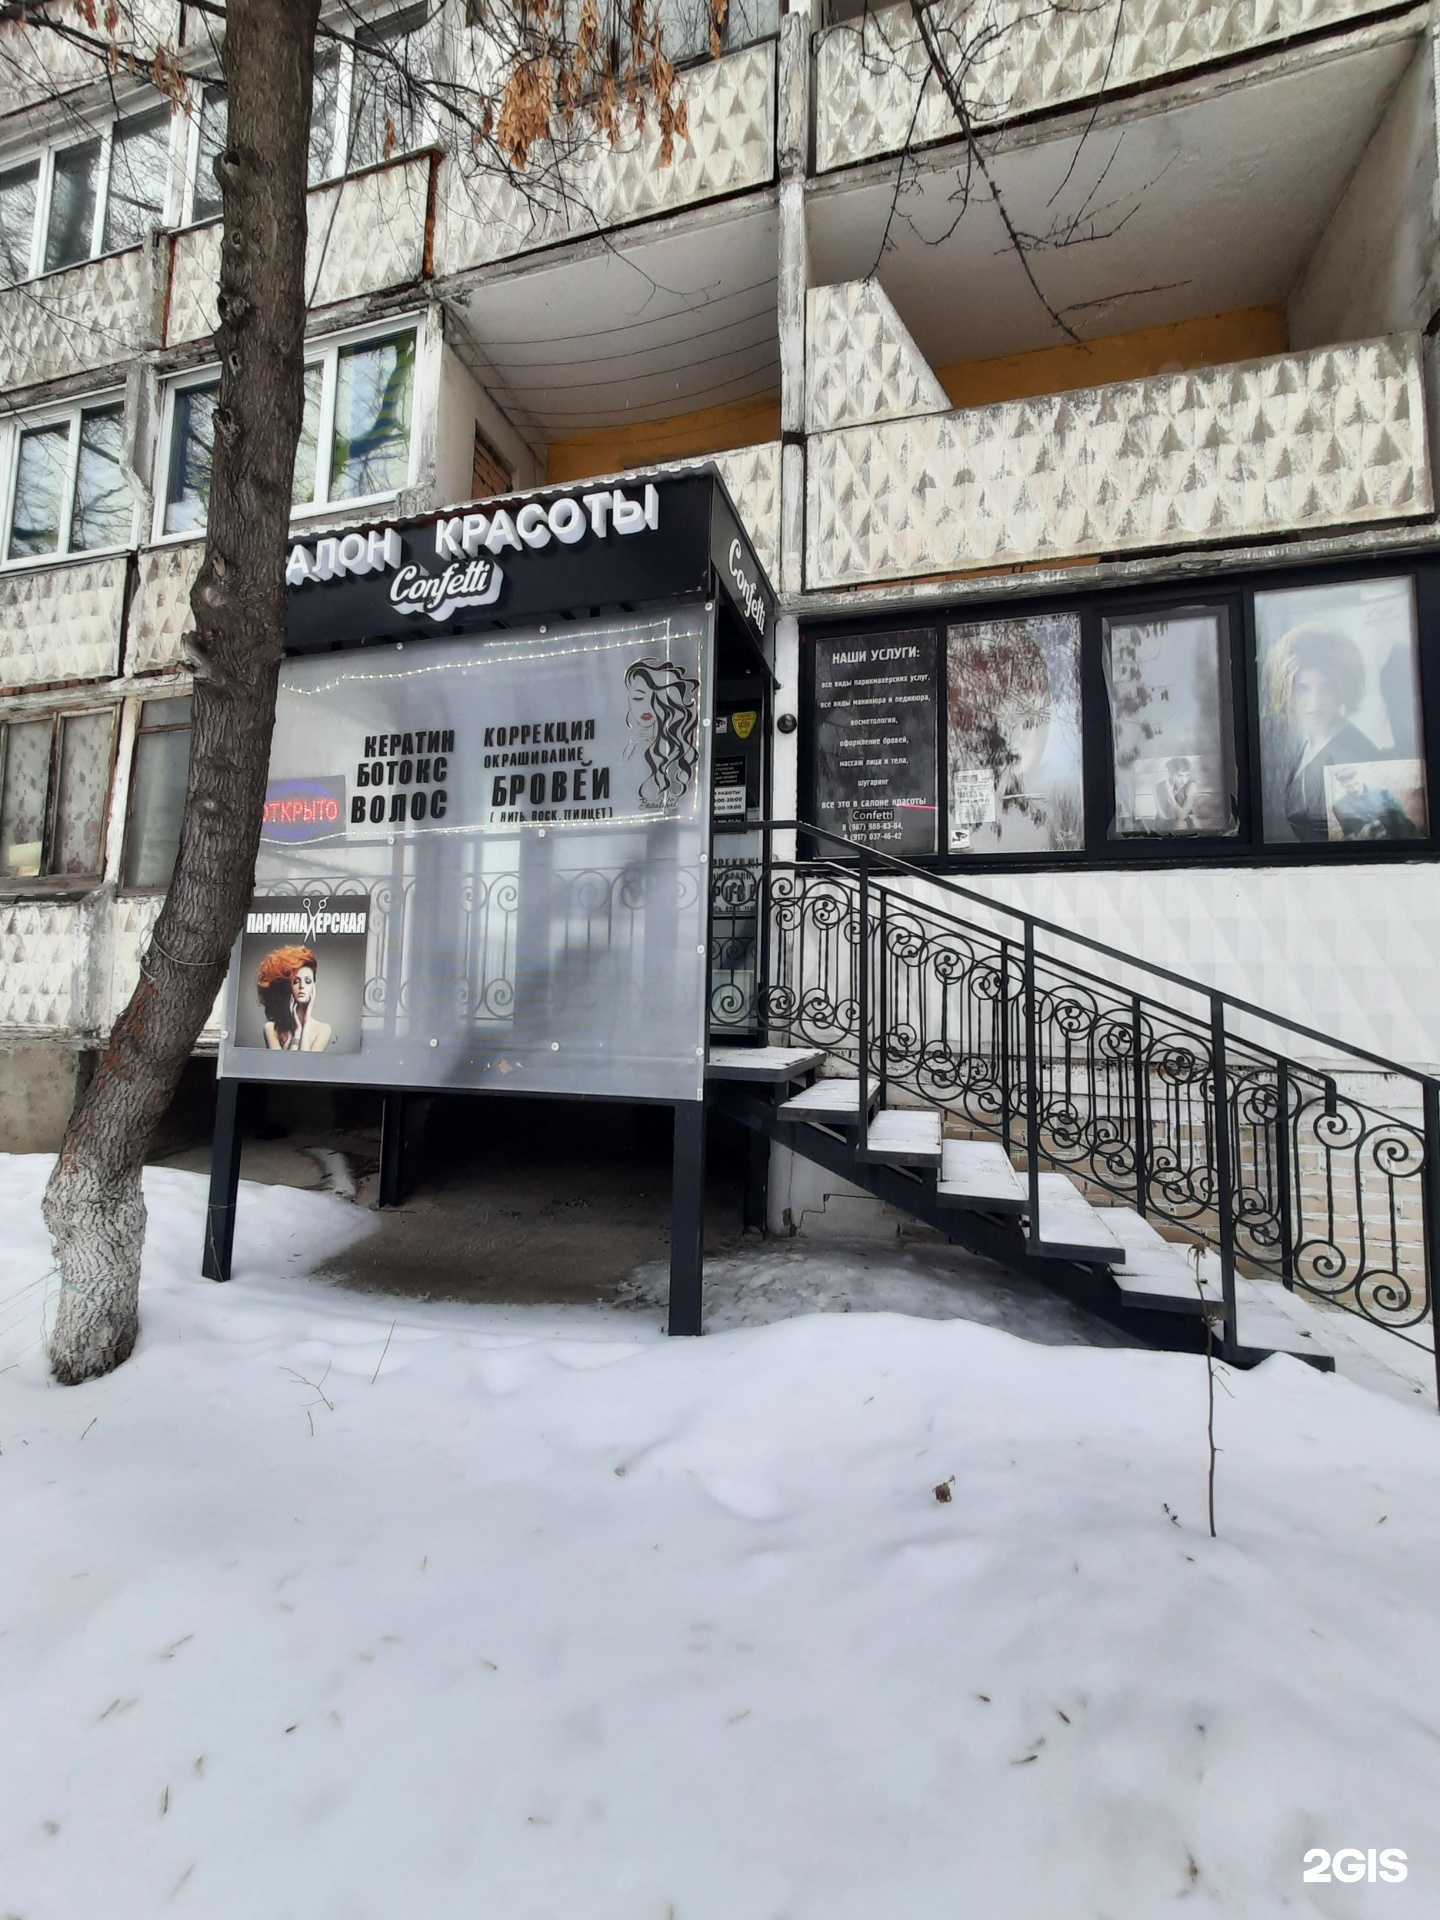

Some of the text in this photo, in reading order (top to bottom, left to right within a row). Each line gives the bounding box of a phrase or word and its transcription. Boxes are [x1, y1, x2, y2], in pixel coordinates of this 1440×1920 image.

[286, 484, 659, 585] АЛОН КРАСОТЫ
[390, 558, 494, 611] Confetti
[728, 538, 767, 636] Confetti
[832, 646, 921, 664] НАШИ УСЛУГИ:
[834, 680, 852, 688] виды
[364, 730, 455, 758] КЕРАТИН
[484, 719, 595, 747] КОРРЕКЦИЯ
[484, 747, 584, 768] ОКРАШИВАНИЕ
[357, 757, 448, 787] БОТОКС
[491, 759, 610, 807] БРОВЕЙ
[857, 779, 890, 788] шугаринг
[351, 789, 448, 824] ВОЛОС
[821, 801, 834, 809] все
[838, 800, 850, 808] это
[861, 799, 889, 807] салоне
[892, 797, 927, 806] красоты
[852, 810, 894, 820] Confetti
[246, 906, 367, 938] ПАРИКМАХЕРСКАЯ
